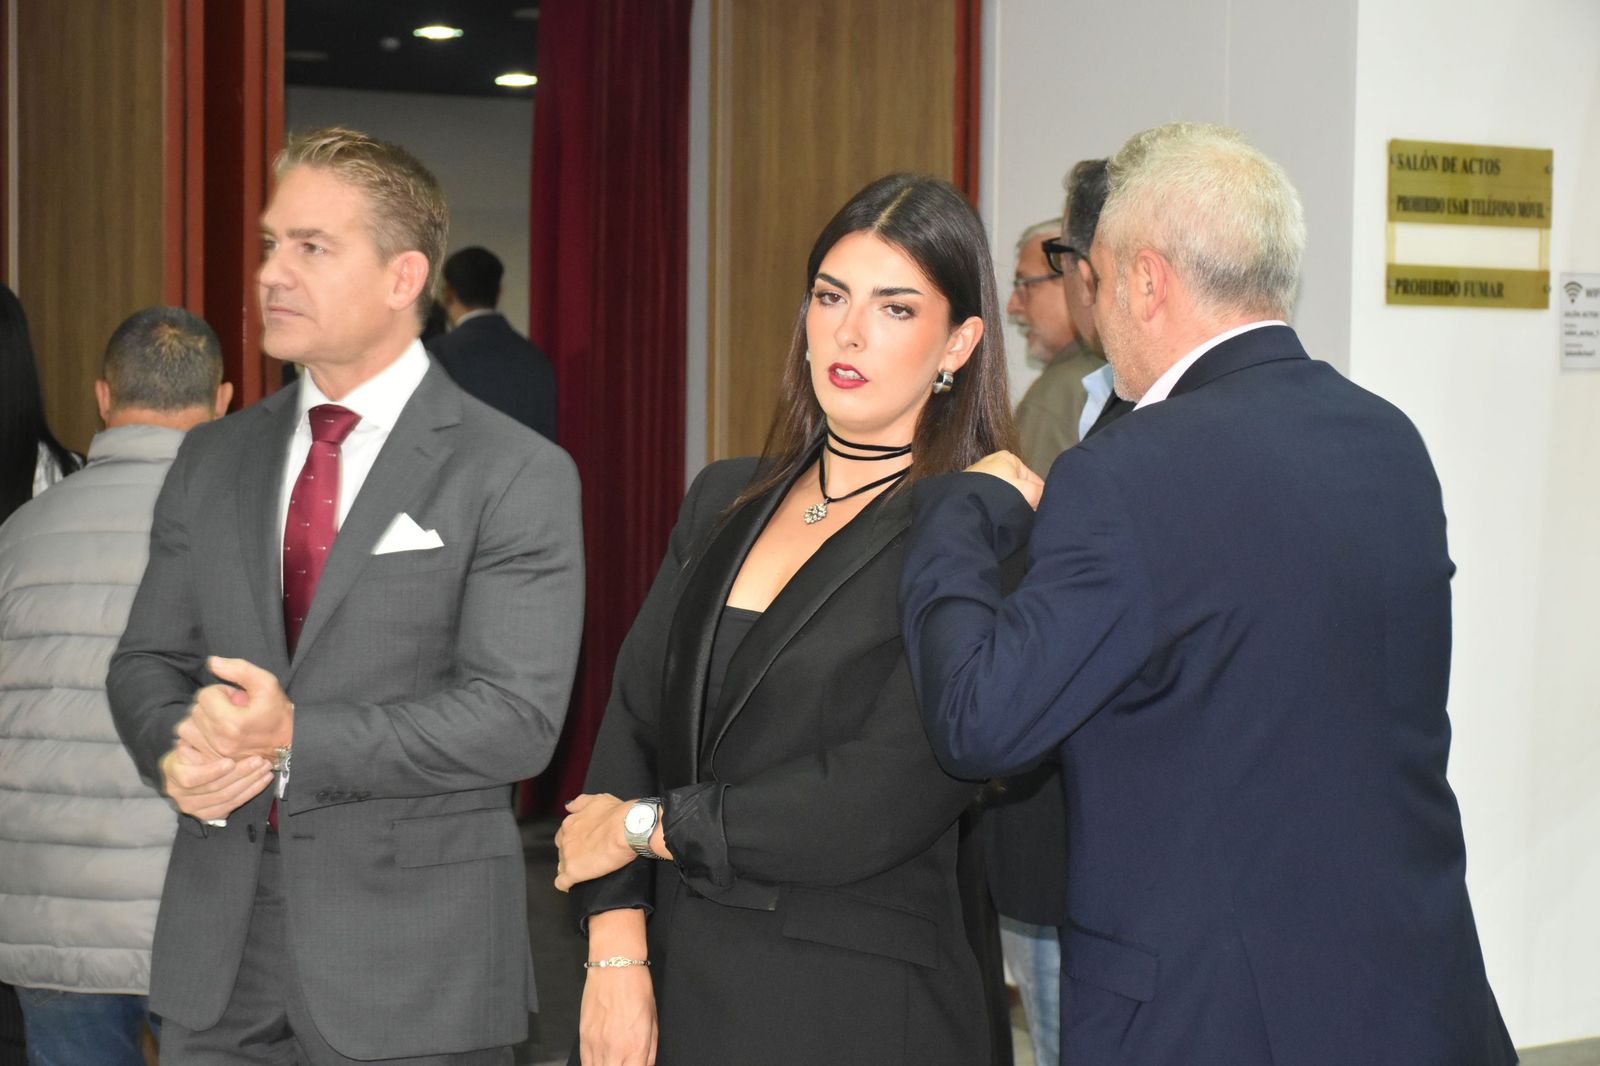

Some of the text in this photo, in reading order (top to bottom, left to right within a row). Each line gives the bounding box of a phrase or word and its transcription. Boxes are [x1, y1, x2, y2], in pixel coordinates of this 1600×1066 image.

[1397, 150, 1501, 176] SALÓN DE ACTOS
[1447, 198, 1469, 215] USAR
[1395, 278, 1504, 298] PROHIBIDO FUMAR
